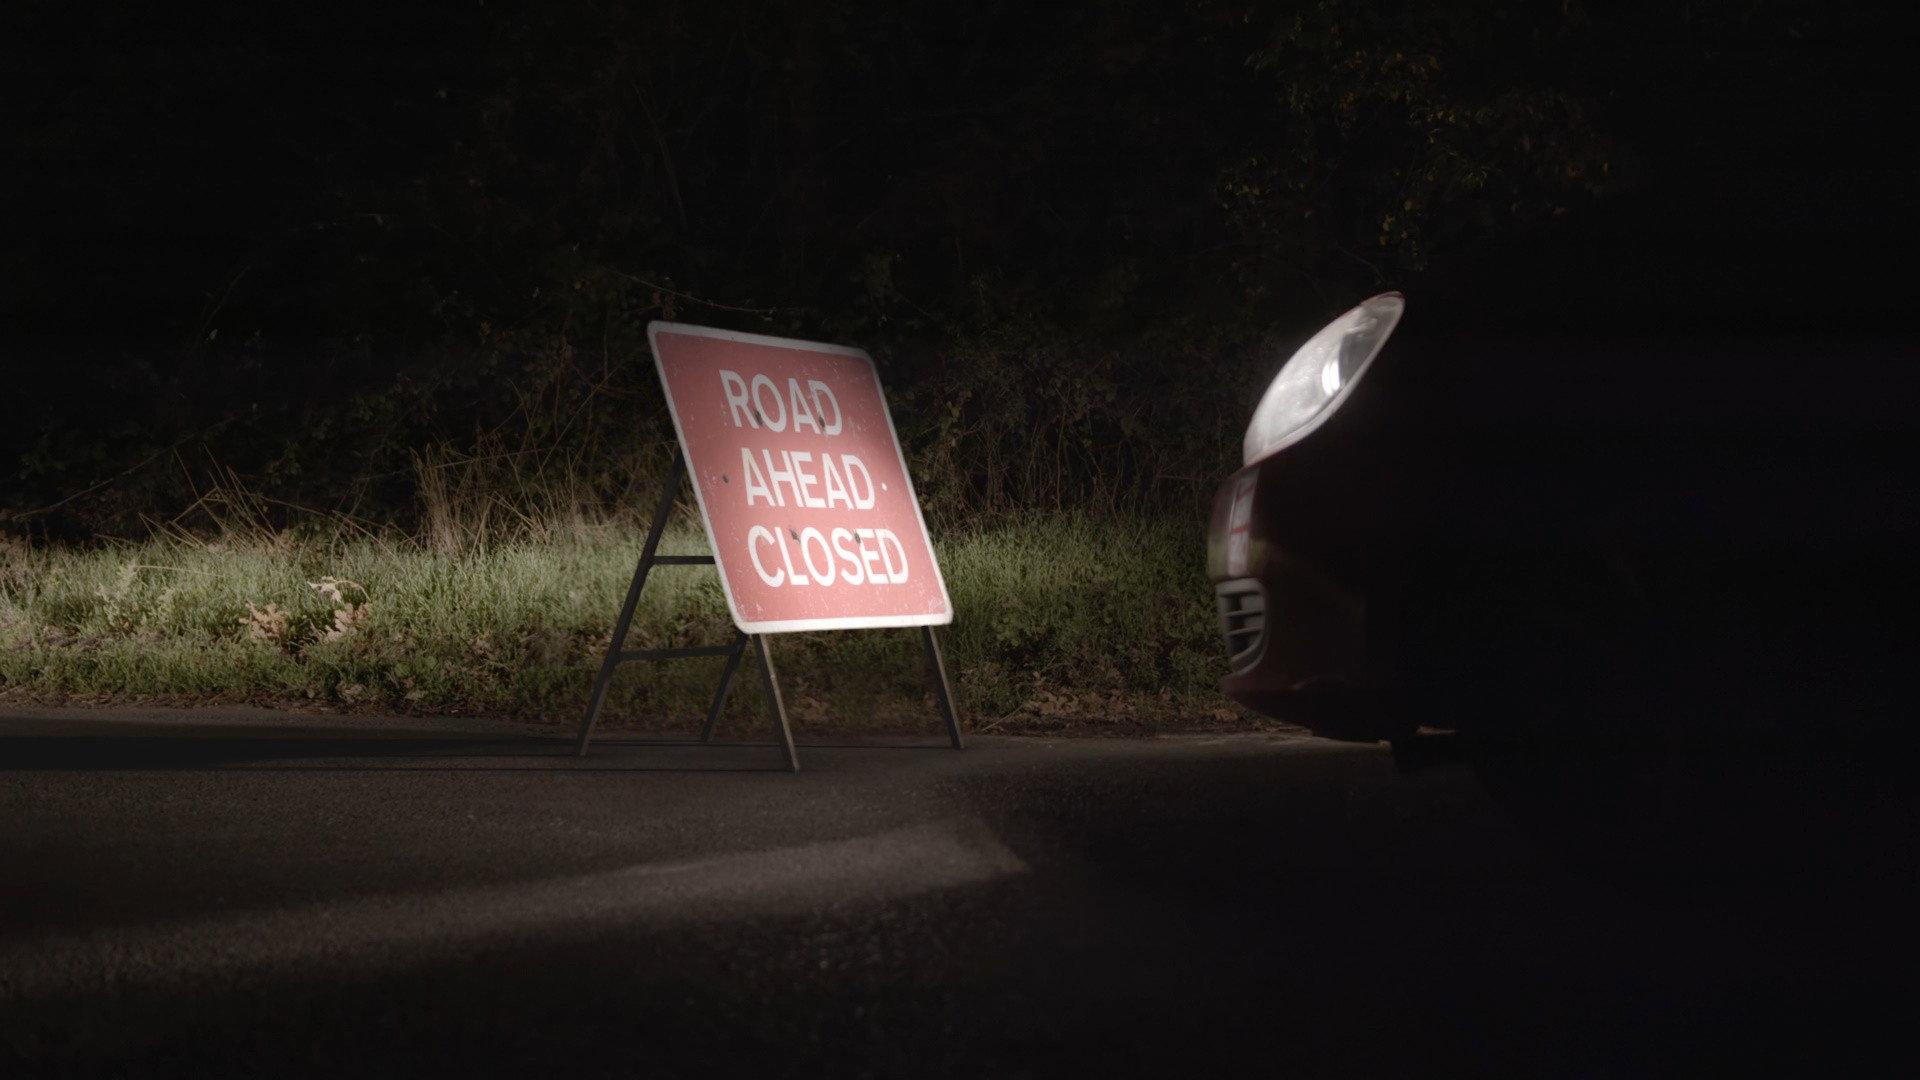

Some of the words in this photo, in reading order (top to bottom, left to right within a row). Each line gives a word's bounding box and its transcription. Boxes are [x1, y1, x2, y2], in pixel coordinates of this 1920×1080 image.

[719, 369, 842, 436] ROAD
[741, 447, 875, 510] AHEAD
[748, 525, 909, 588] CLOSED
